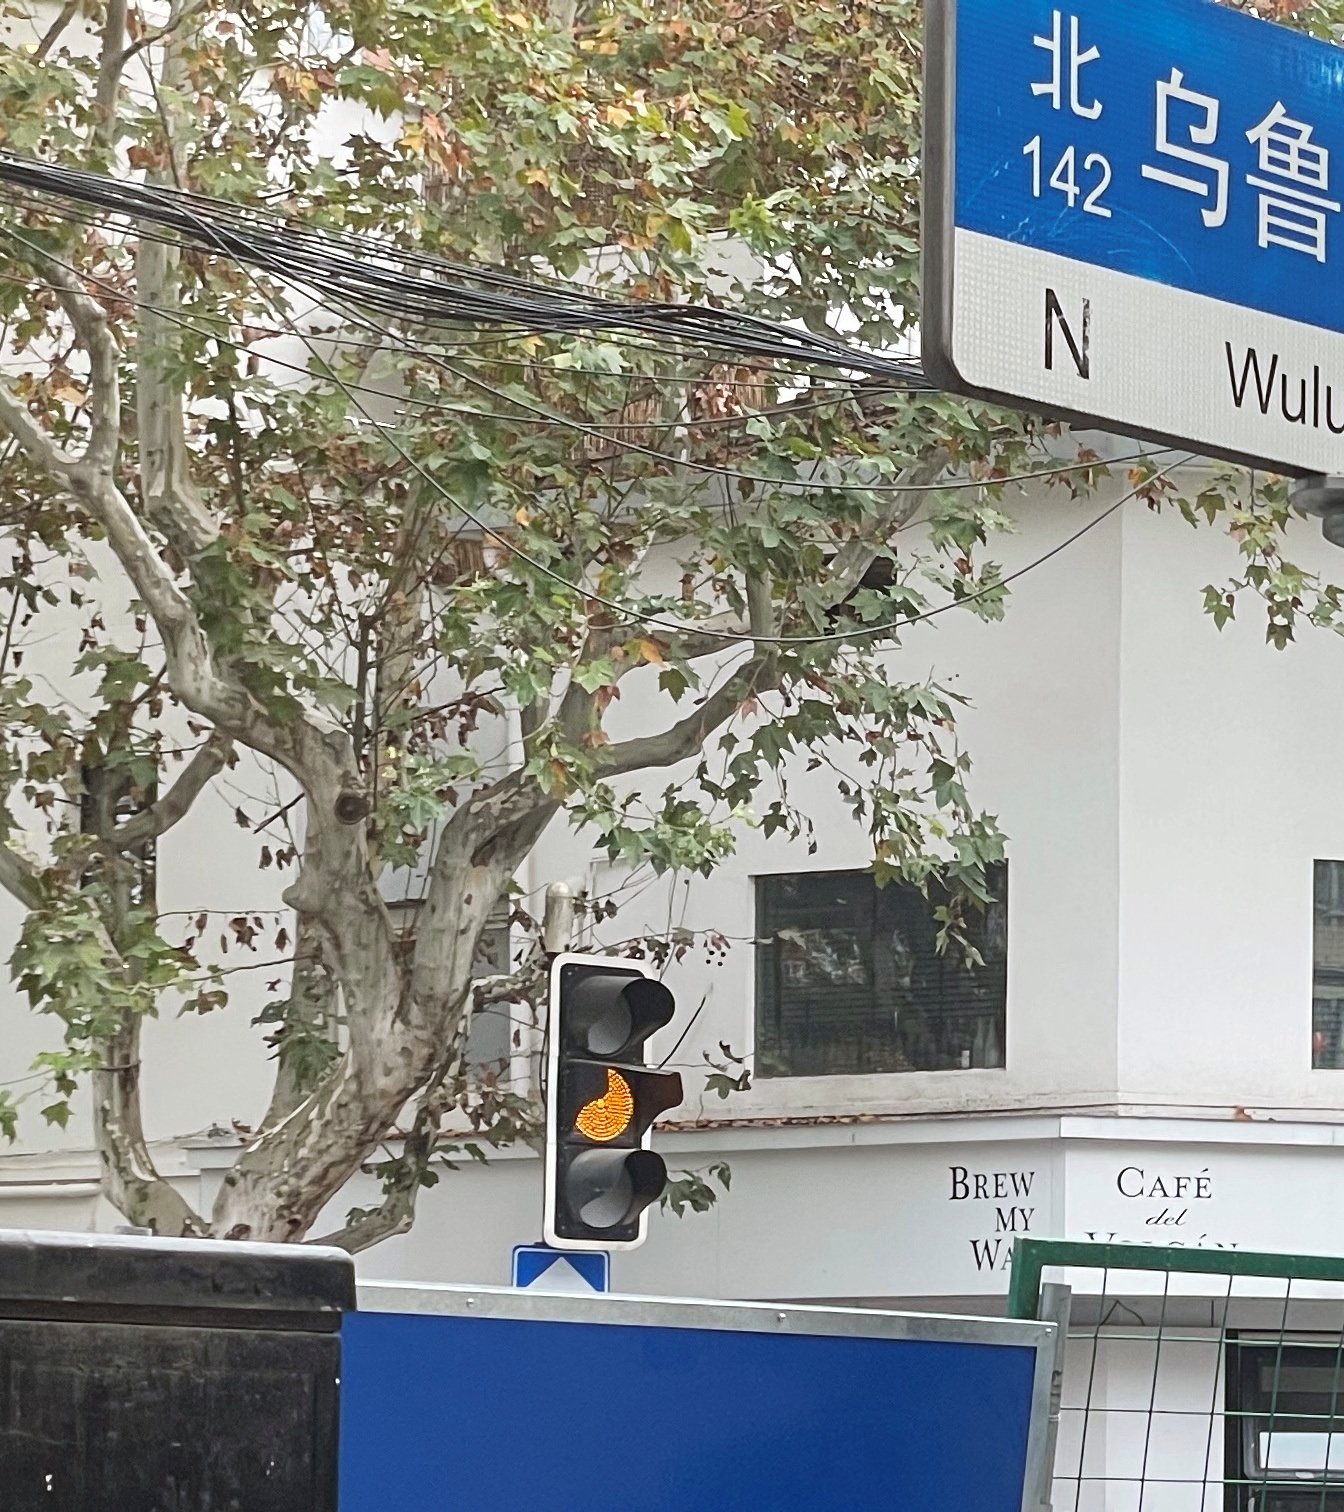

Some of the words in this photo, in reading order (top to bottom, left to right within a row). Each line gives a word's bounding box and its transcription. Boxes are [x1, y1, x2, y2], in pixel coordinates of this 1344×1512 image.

[1029, 10, 1105, 121] 北
[1022, 135, 1114, 219] 142
[1043, 288, 1091, 381] N
[995, 1206, 1036, 1232] MY
[1145, 1207, 1188, 1226] del
